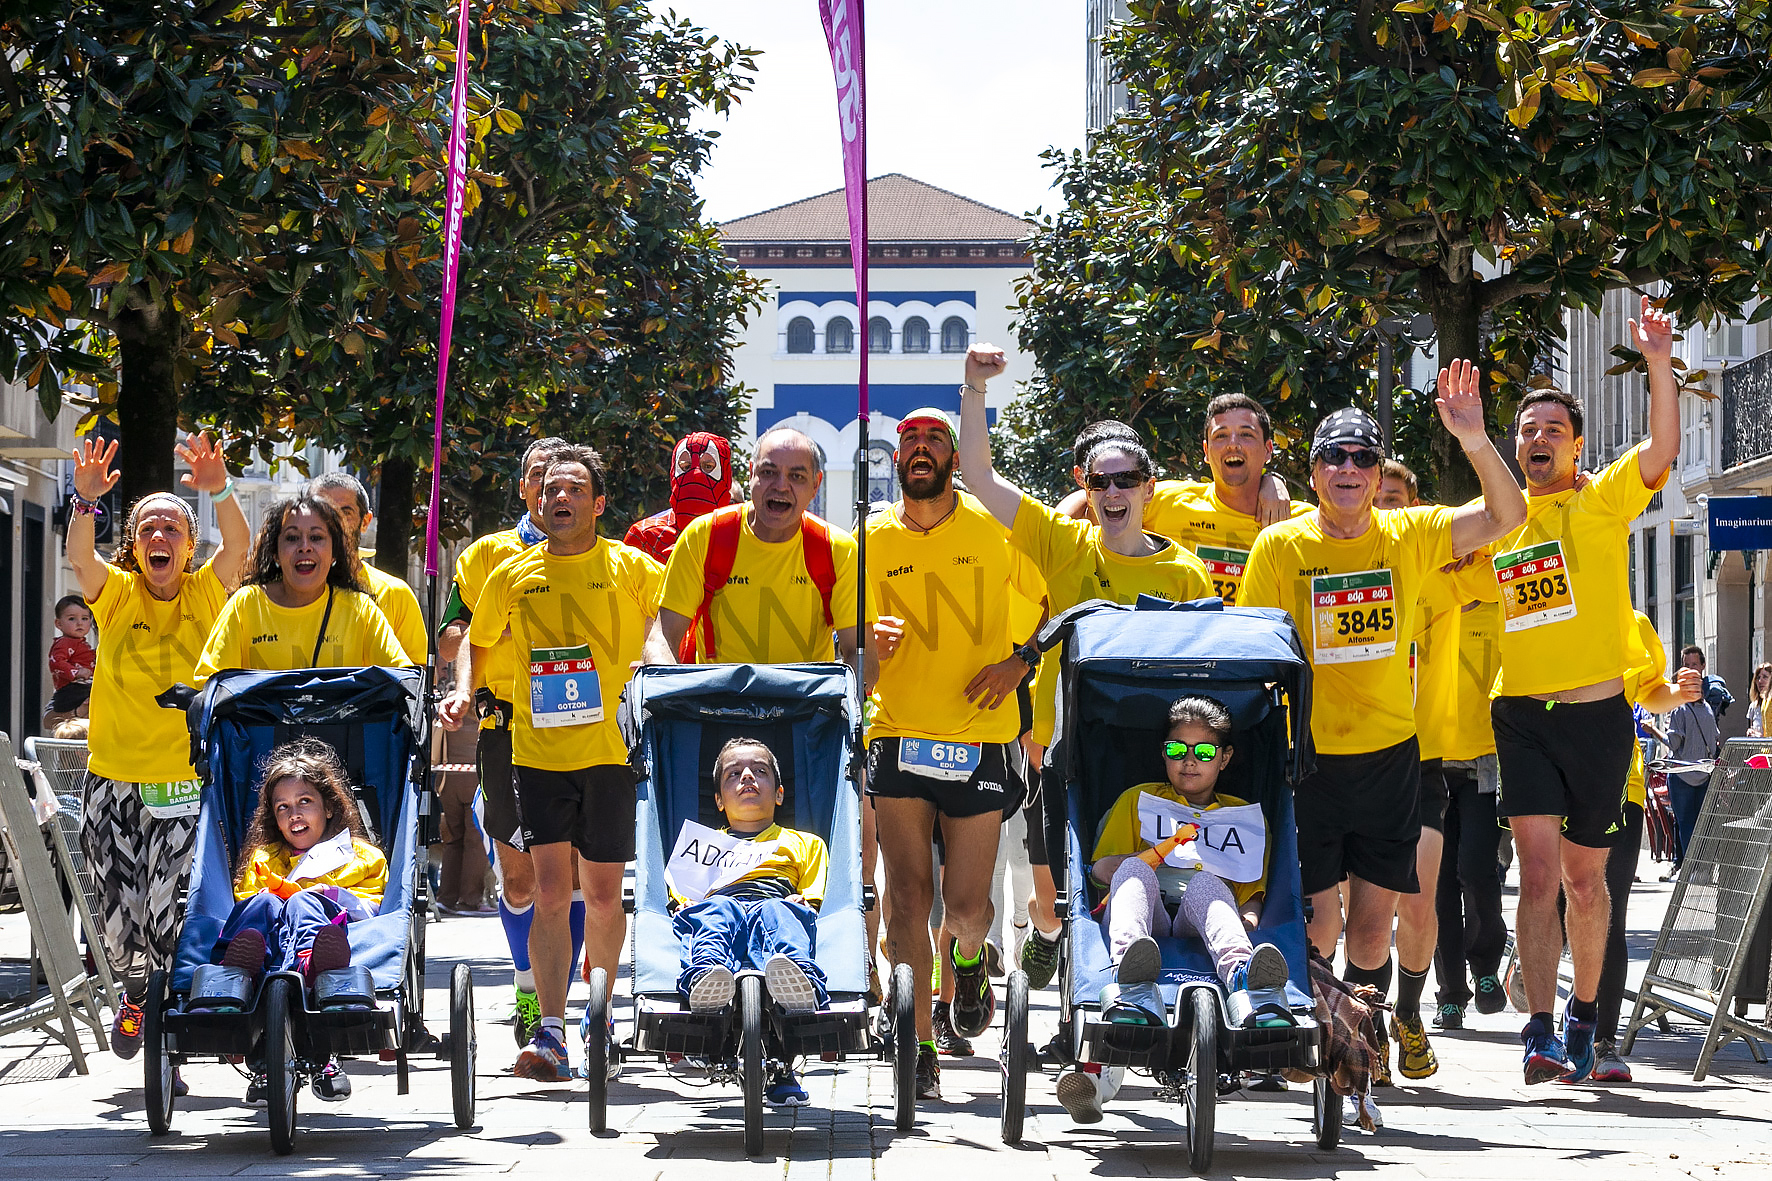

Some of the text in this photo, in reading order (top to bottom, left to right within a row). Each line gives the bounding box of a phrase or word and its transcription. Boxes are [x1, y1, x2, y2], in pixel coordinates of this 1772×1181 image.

[1715, 517, 1772, 529] Imaginarium
[886, 564, 914, 578] aefat
[1205, 560, 1241, 577] dp edp
[1298, 566, 1329, 577] aefat
[1501, 557, 1559, 580] edp edp edp
[726, 575, 749, 585] efat
[523, 585, 551, 595] aefat
[1212, 580, 1241, 602] 32
[1515, 573, 1567, 604] 3303
[1319, 587, 1388, 606] edp edp edp
[1527, 602, 1547, 611] AITOR
[1337, 607, 1394, 635] 3845
[1347, 636, 1375, 644] Alfonso
[553, 661, 569, 674] edp
[576, 659, 592, 671] edp
[565, 678, 579, 701] 8
[557, 701, 587, 710] GOTZON
[931, 743, 969, 764] 618
